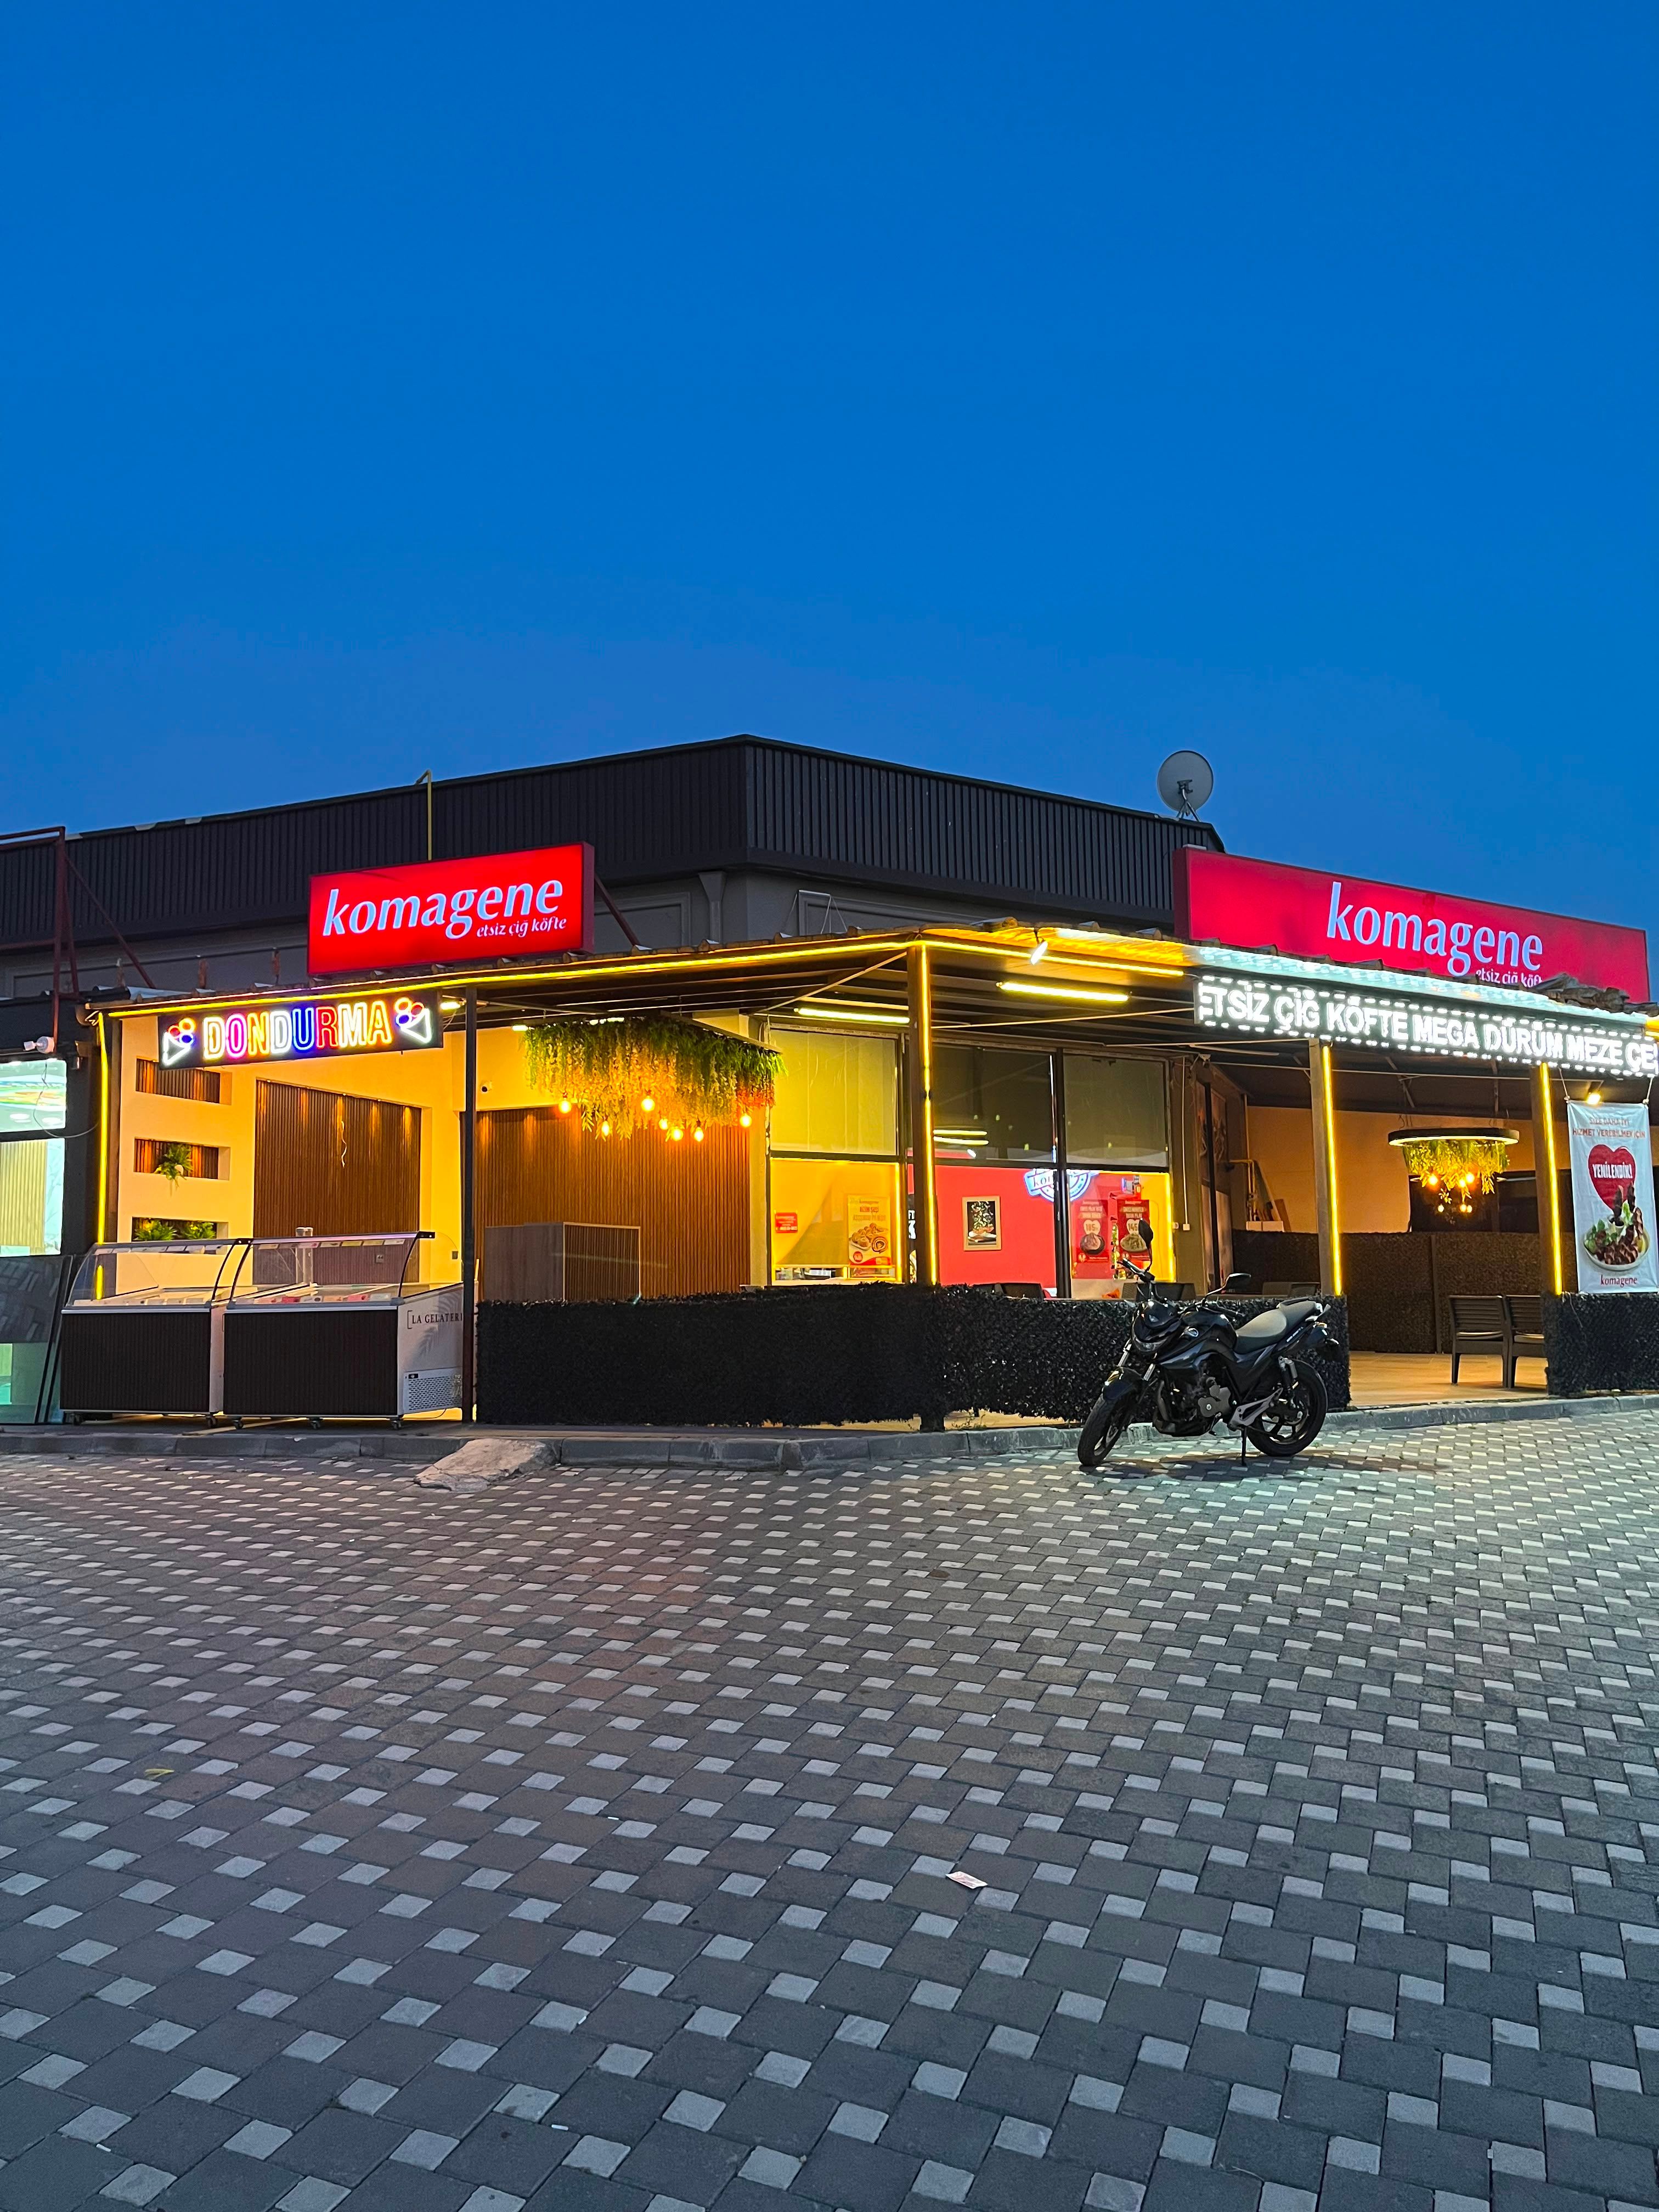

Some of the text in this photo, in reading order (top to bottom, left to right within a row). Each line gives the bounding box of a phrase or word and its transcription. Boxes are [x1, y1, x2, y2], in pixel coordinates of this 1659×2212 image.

[323, 879, 563, 940] komagene
[477, 916, 567, 938] etsiz çiğ köfte
[1327, 881, 1543, 977] komagene
[1476, 968, 1500, 984] etsiz
[203, 1000, 392, 1059] DONDURMA
[1273, 989, 1320, 1031] ÇİĞ
[1326, 996, 1409, 1041] KÖFTE
[1412, 1014, 1481, 1049] MEGA
[1483, 1018, 1564, 1059] DÜRÜM
[1566, 1035, 1623, 1066] MEZE
[1600, 1274, 1638, 1288] komagene
[412, 1312, 462, 1324] LA GELATERI
